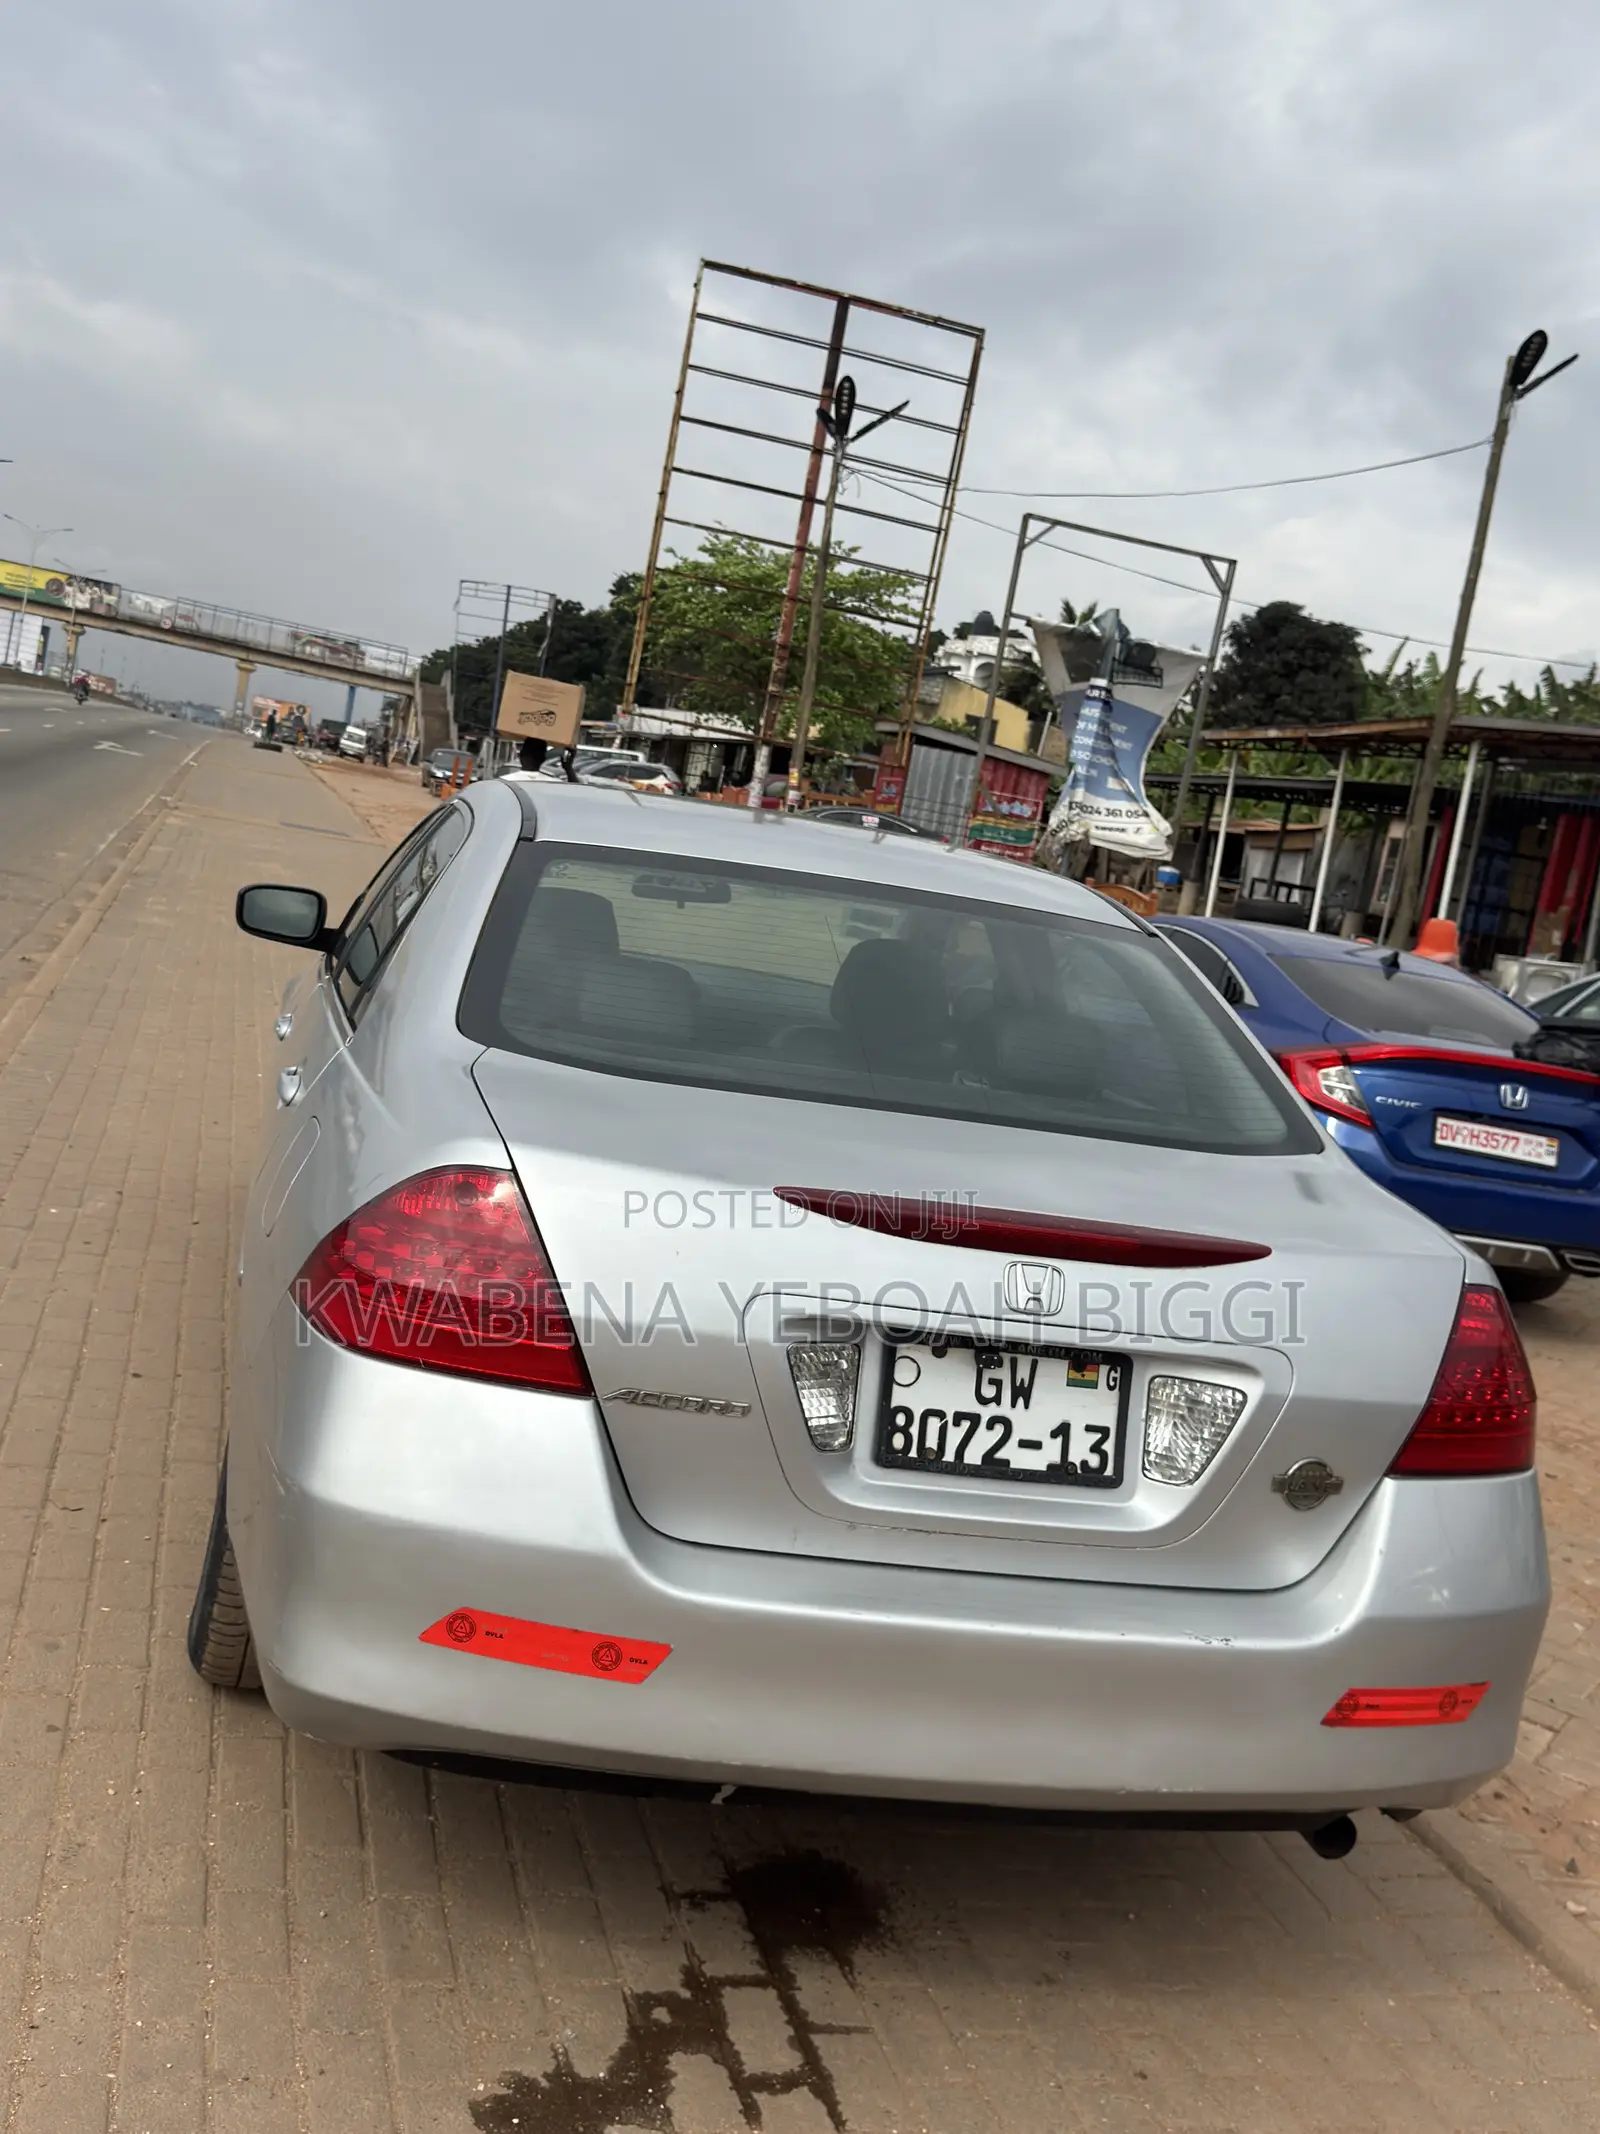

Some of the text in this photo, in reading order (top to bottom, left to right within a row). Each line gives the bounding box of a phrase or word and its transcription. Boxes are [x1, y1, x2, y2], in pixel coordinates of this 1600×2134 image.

[1375, 1096, 1423, 1109] CIVIC
[975, 1356, 1119, 1410] GW G
[602, 1387, 753, 1418] ACCORD
[889, 1406, 1111, 1476] 8072-13
[485, 1630, 504, 1639] DVLA
[629, 1657, 648, 1665] DVLA
